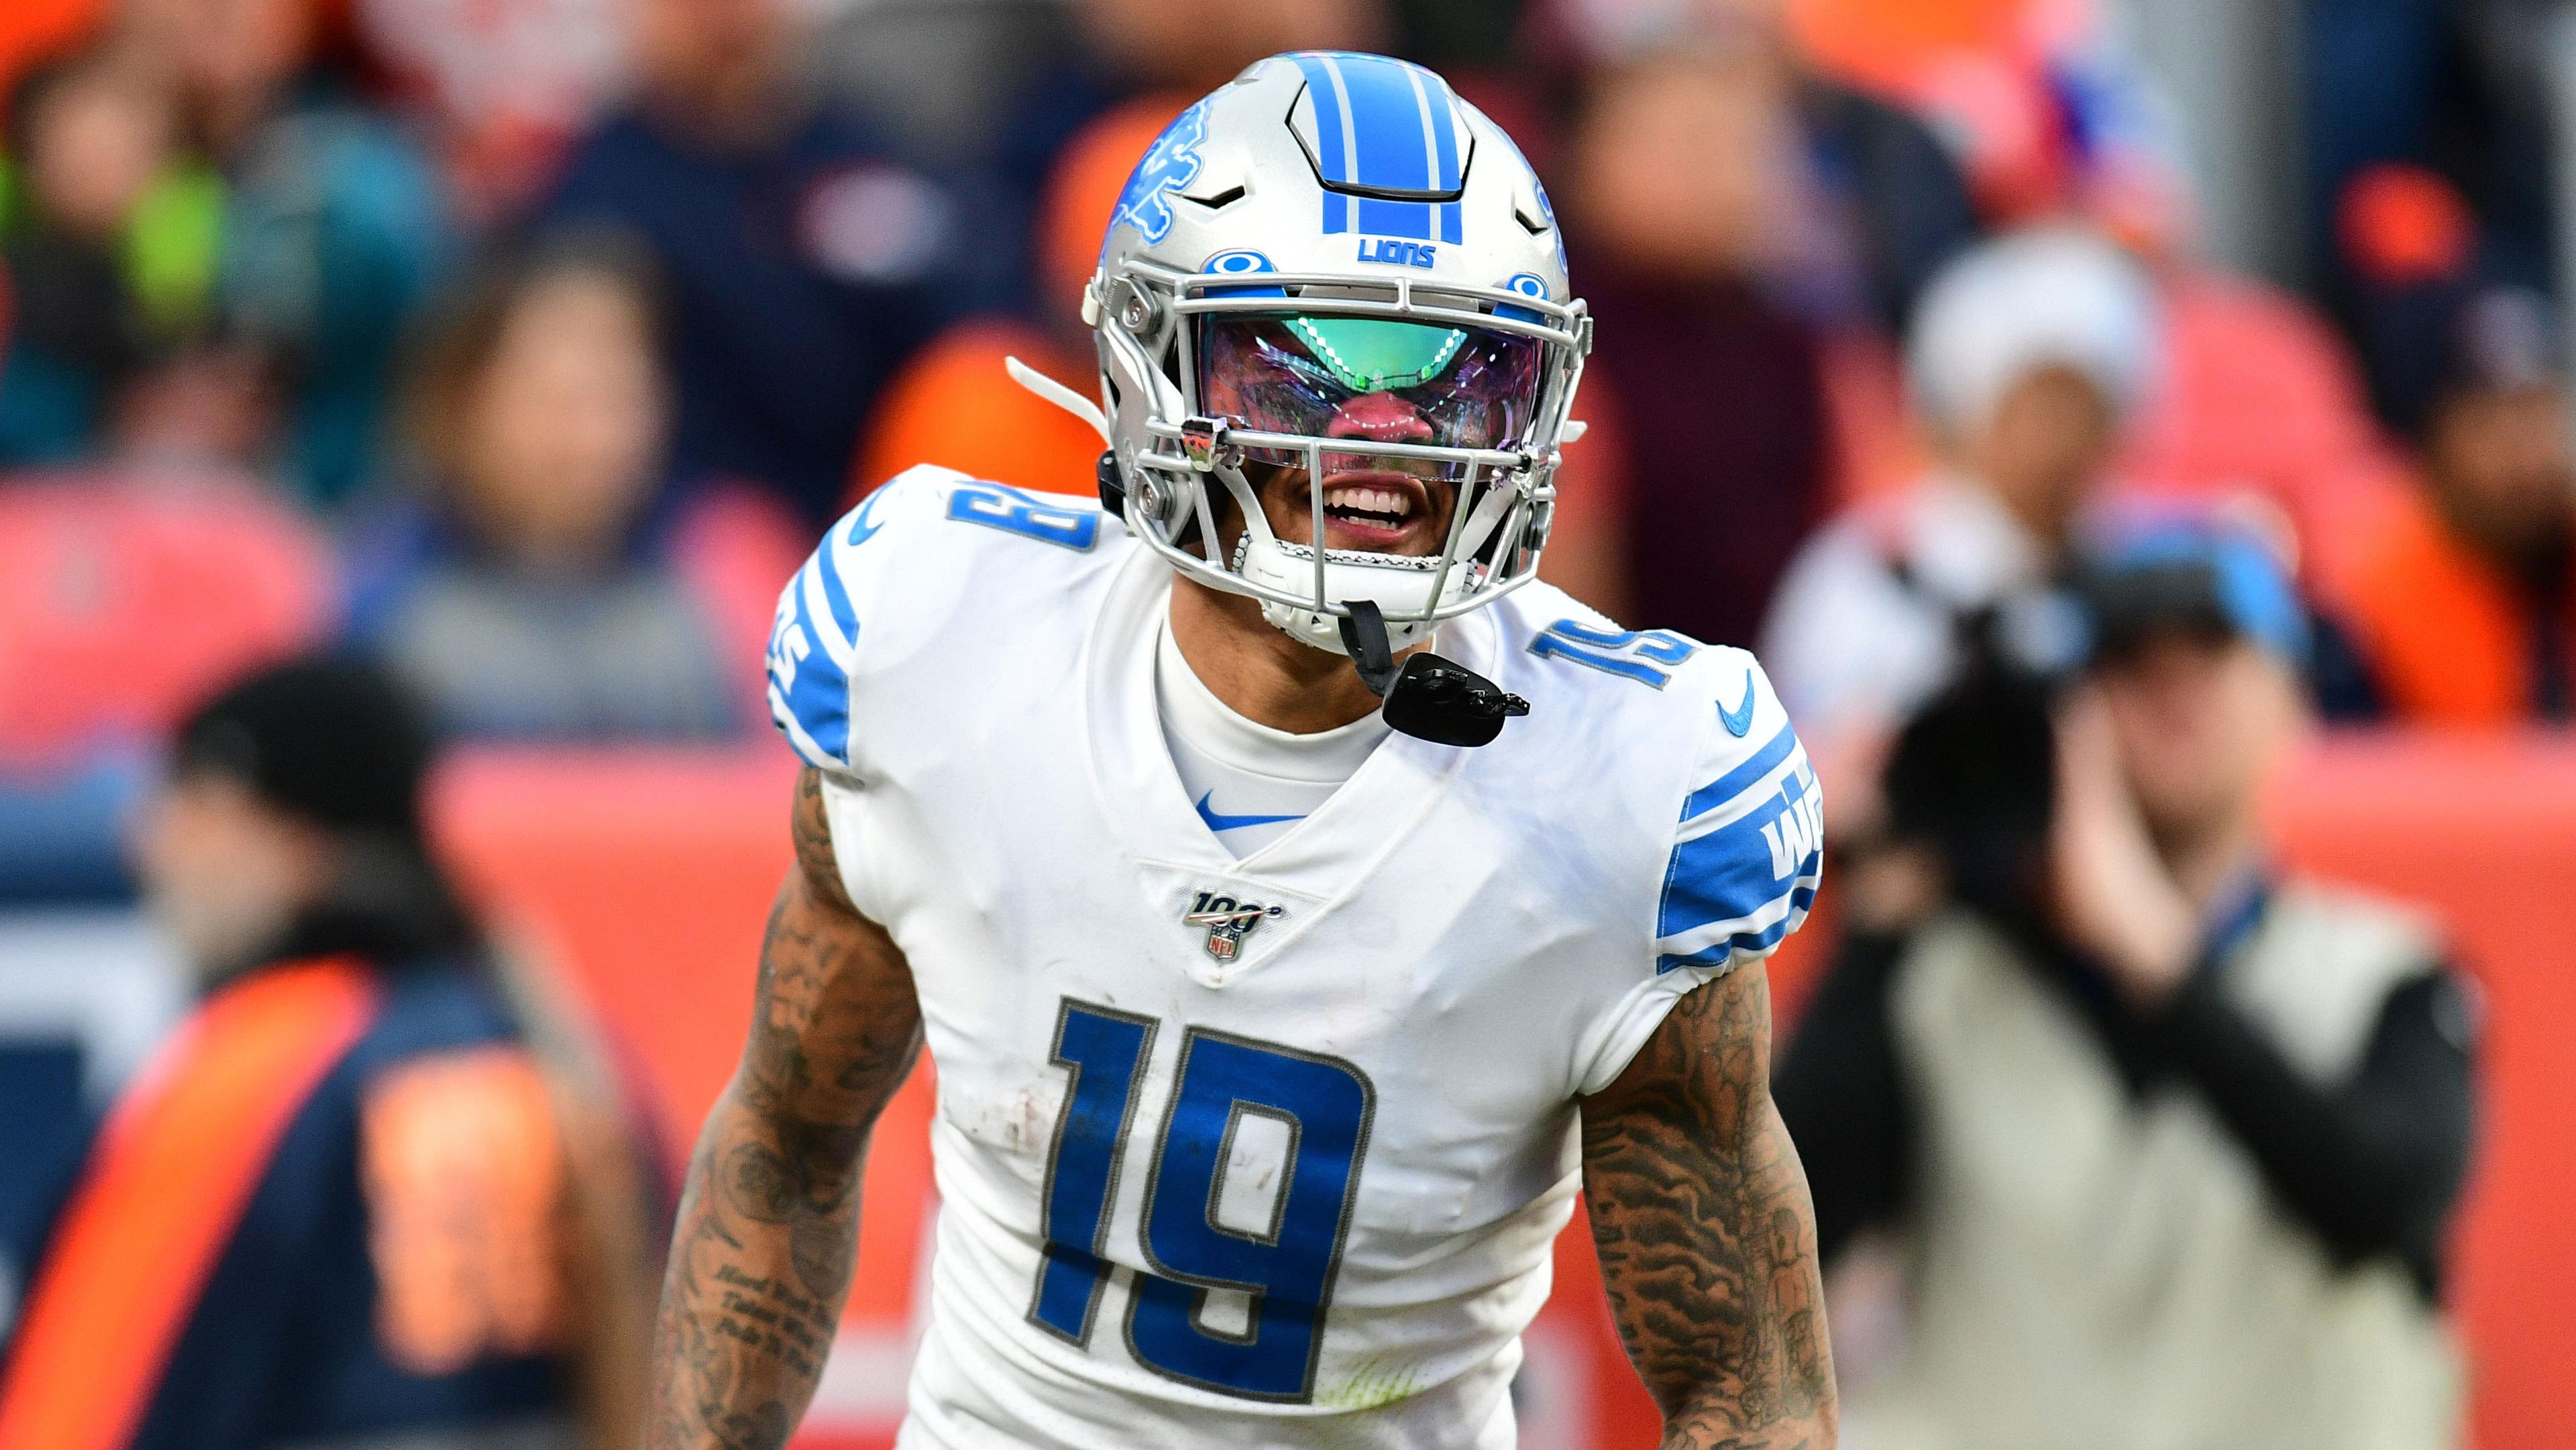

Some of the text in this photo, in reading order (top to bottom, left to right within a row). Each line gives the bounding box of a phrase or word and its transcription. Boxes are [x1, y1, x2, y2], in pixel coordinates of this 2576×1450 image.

[1357, 239, 1436, 268] LIONS
[1210, 938, 1236, 957] NFL
[1024, 994, 1377, 1405] 19
